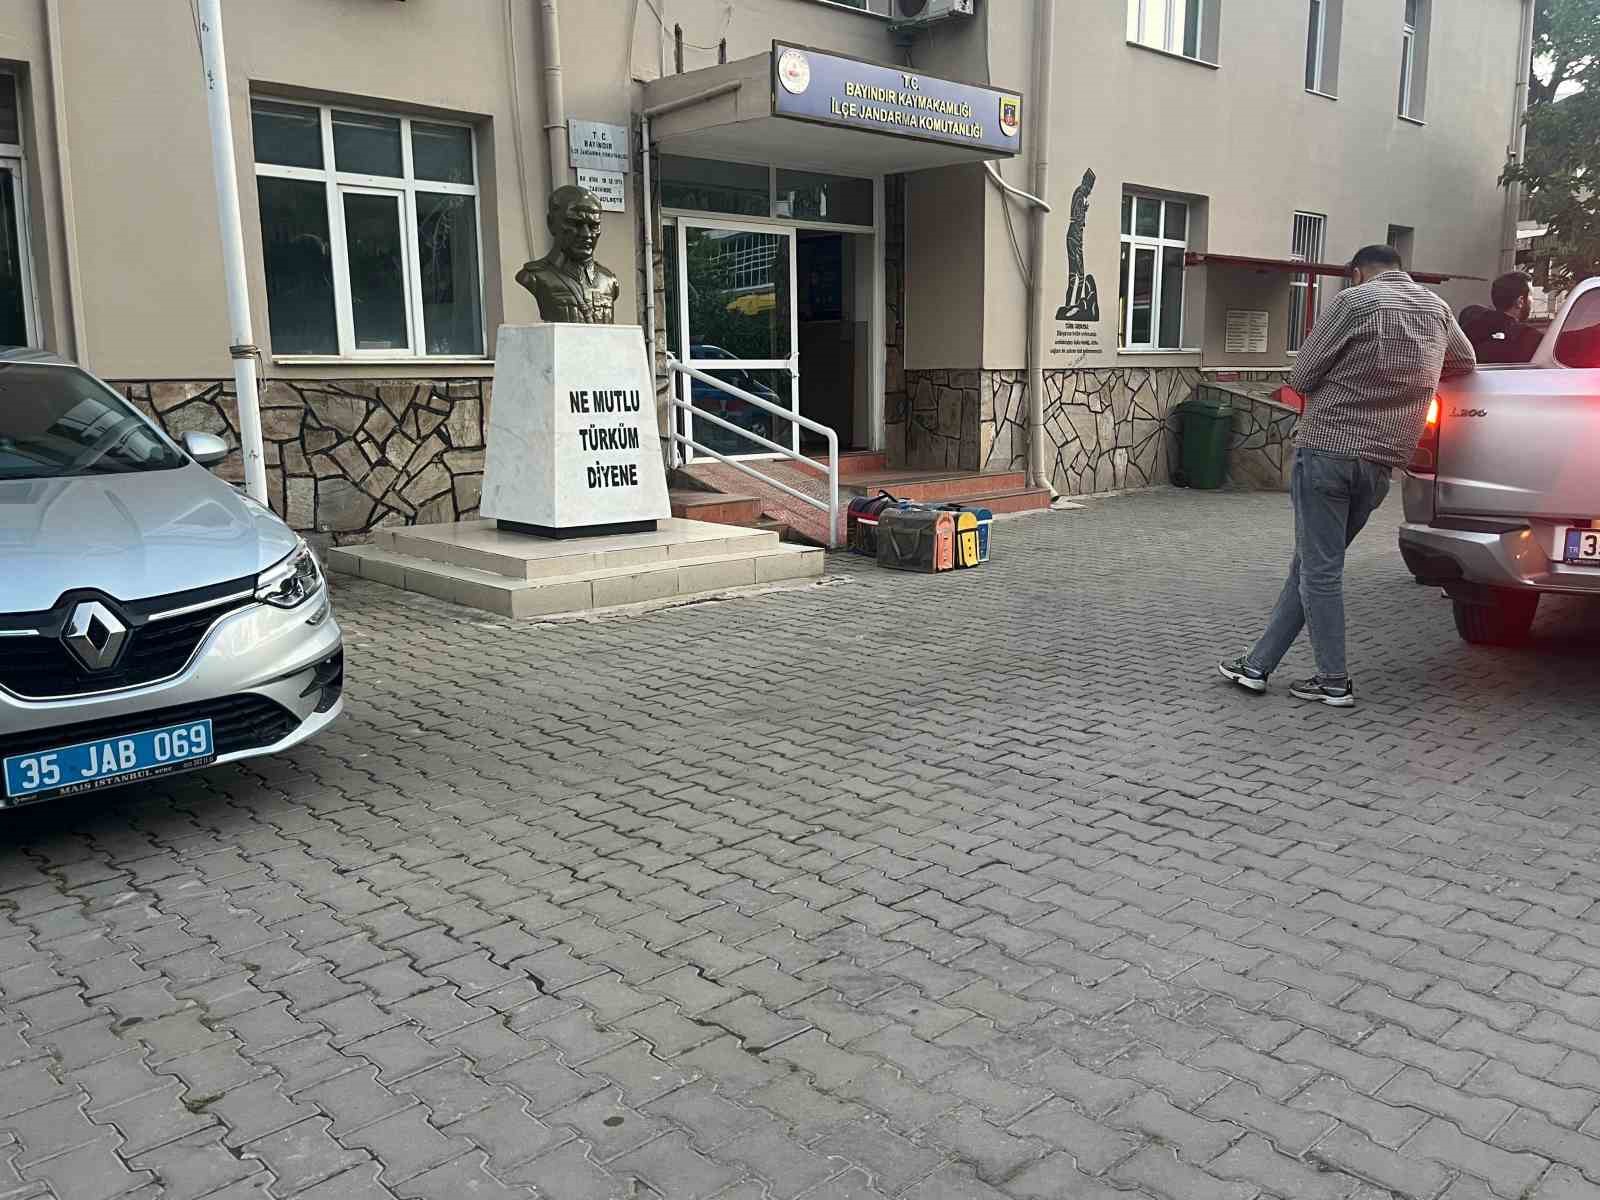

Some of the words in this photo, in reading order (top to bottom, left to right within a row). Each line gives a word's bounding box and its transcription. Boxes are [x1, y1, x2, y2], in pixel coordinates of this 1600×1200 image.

[845, 81, 896, 104] BAYINDIR
[899, 92, 972, 118] KAYMAKAMLIĞI
[831, 96, 857, 119] İLÇE
[860, 104, 918, 128] JANDARMA
[918, 115, 983, 139] KOMUTANLIĞI
[584, 140, 613, 150] BAYINDIR
[569, 390, 590, 413] NE
[592, 390, 640, 413] MUTLU
[579, 422, 640, 451] TÜRKÜM
[586, 460, 638, 488] DİYENE
[1583, 535, 1600, 557] 3
[19, 754, 61, 789] 35
[80, 739, 137, 777] JAB
[153, 724, 207, 761] 069
